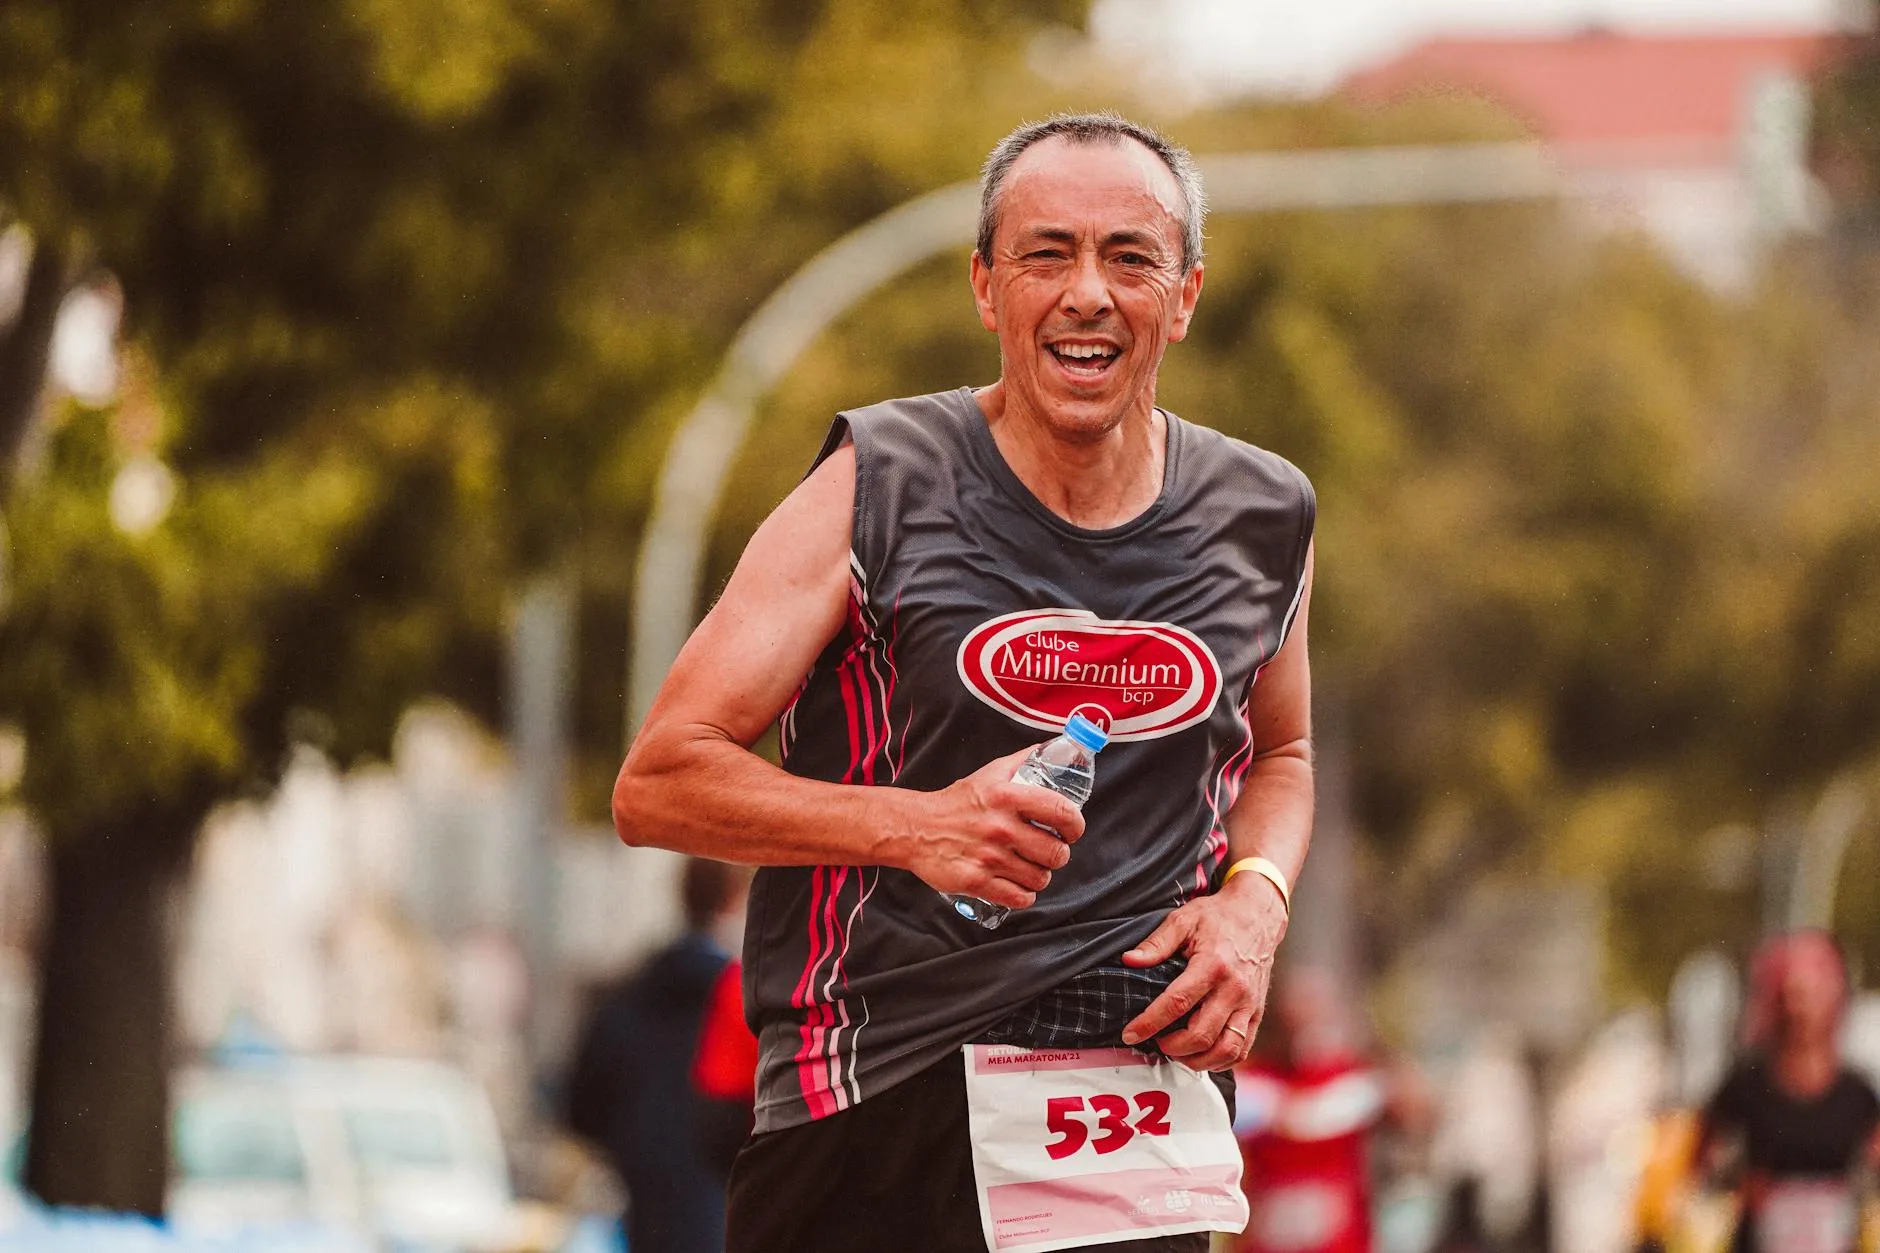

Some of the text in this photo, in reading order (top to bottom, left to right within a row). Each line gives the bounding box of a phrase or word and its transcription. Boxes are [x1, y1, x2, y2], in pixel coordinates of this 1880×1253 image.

[1026, 632, 1080, 653] clube
[1000, 642, 1180, 685] Millennium
[1122, 689, 1154, 706] bcp
[988, 1052, 1081, 1065] MEIA MARATONA'21
[1045, 1090, 1171, 1160] 532
[996, 1212, 1053, 1225] FERNANDO RODRIGUES
